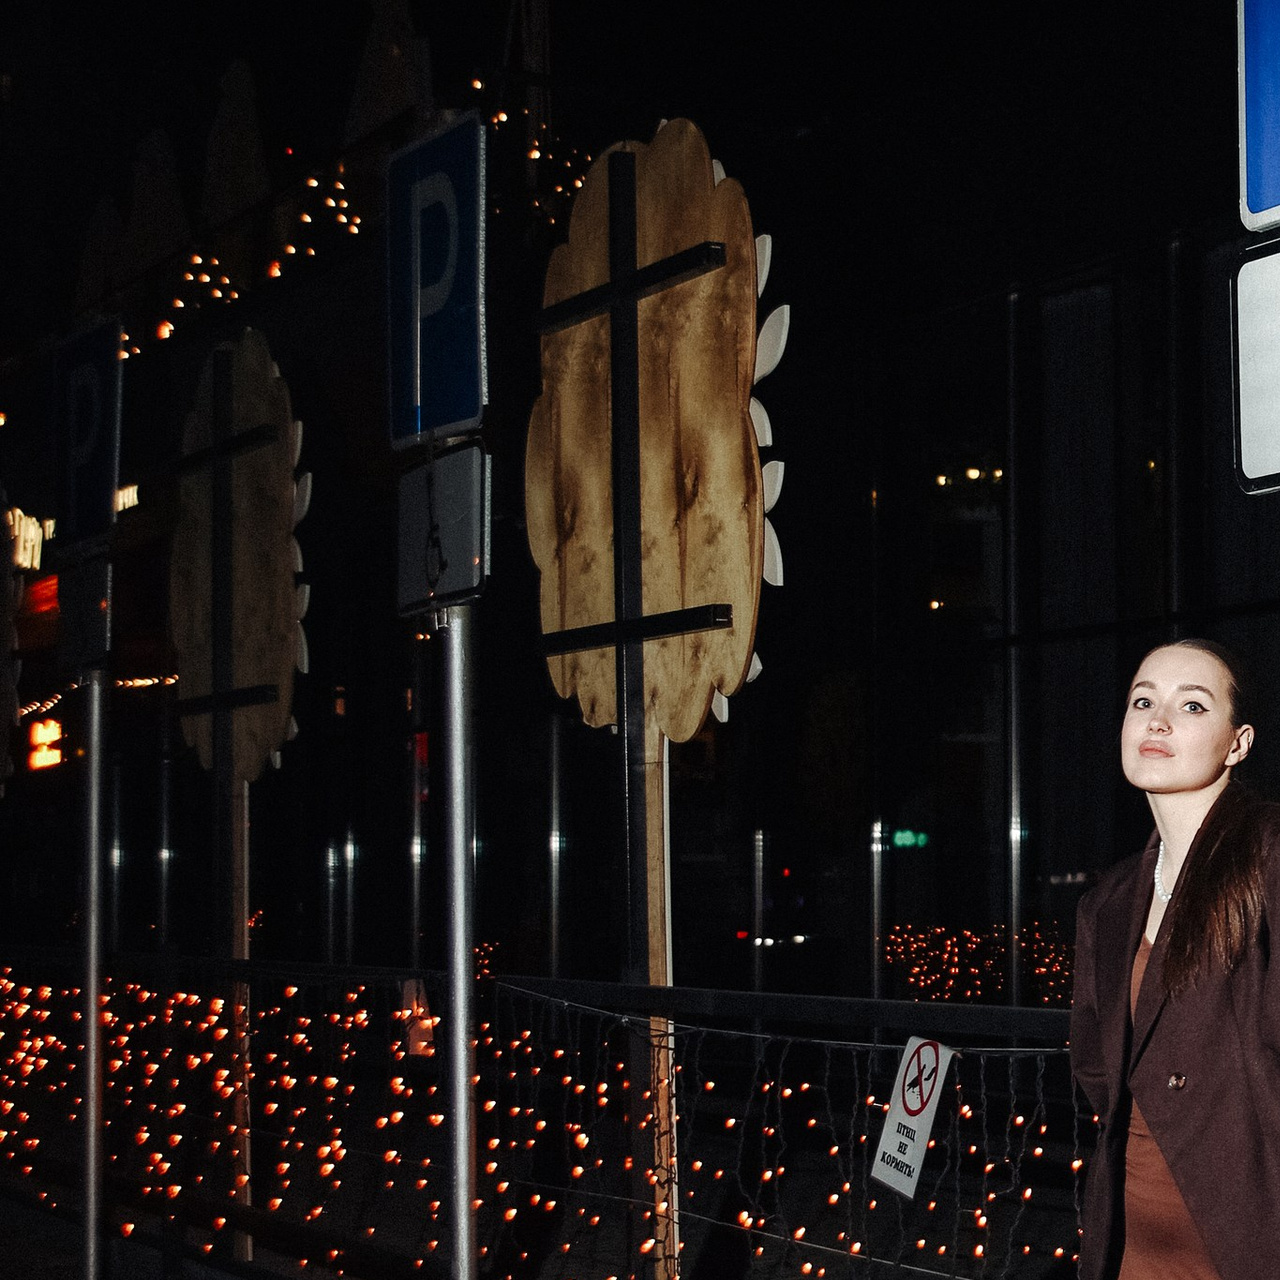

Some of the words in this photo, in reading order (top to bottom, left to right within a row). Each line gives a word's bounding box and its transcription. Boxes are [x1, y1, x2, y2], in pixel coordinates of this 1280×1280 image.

[411, 171, 459, 407] P
[896, 1122, 916, 1142] ПТИЦ
[897, 1141, 908, 1155] НЕ
[880, 1151, 915, 1178] КОРМИТЬ!
